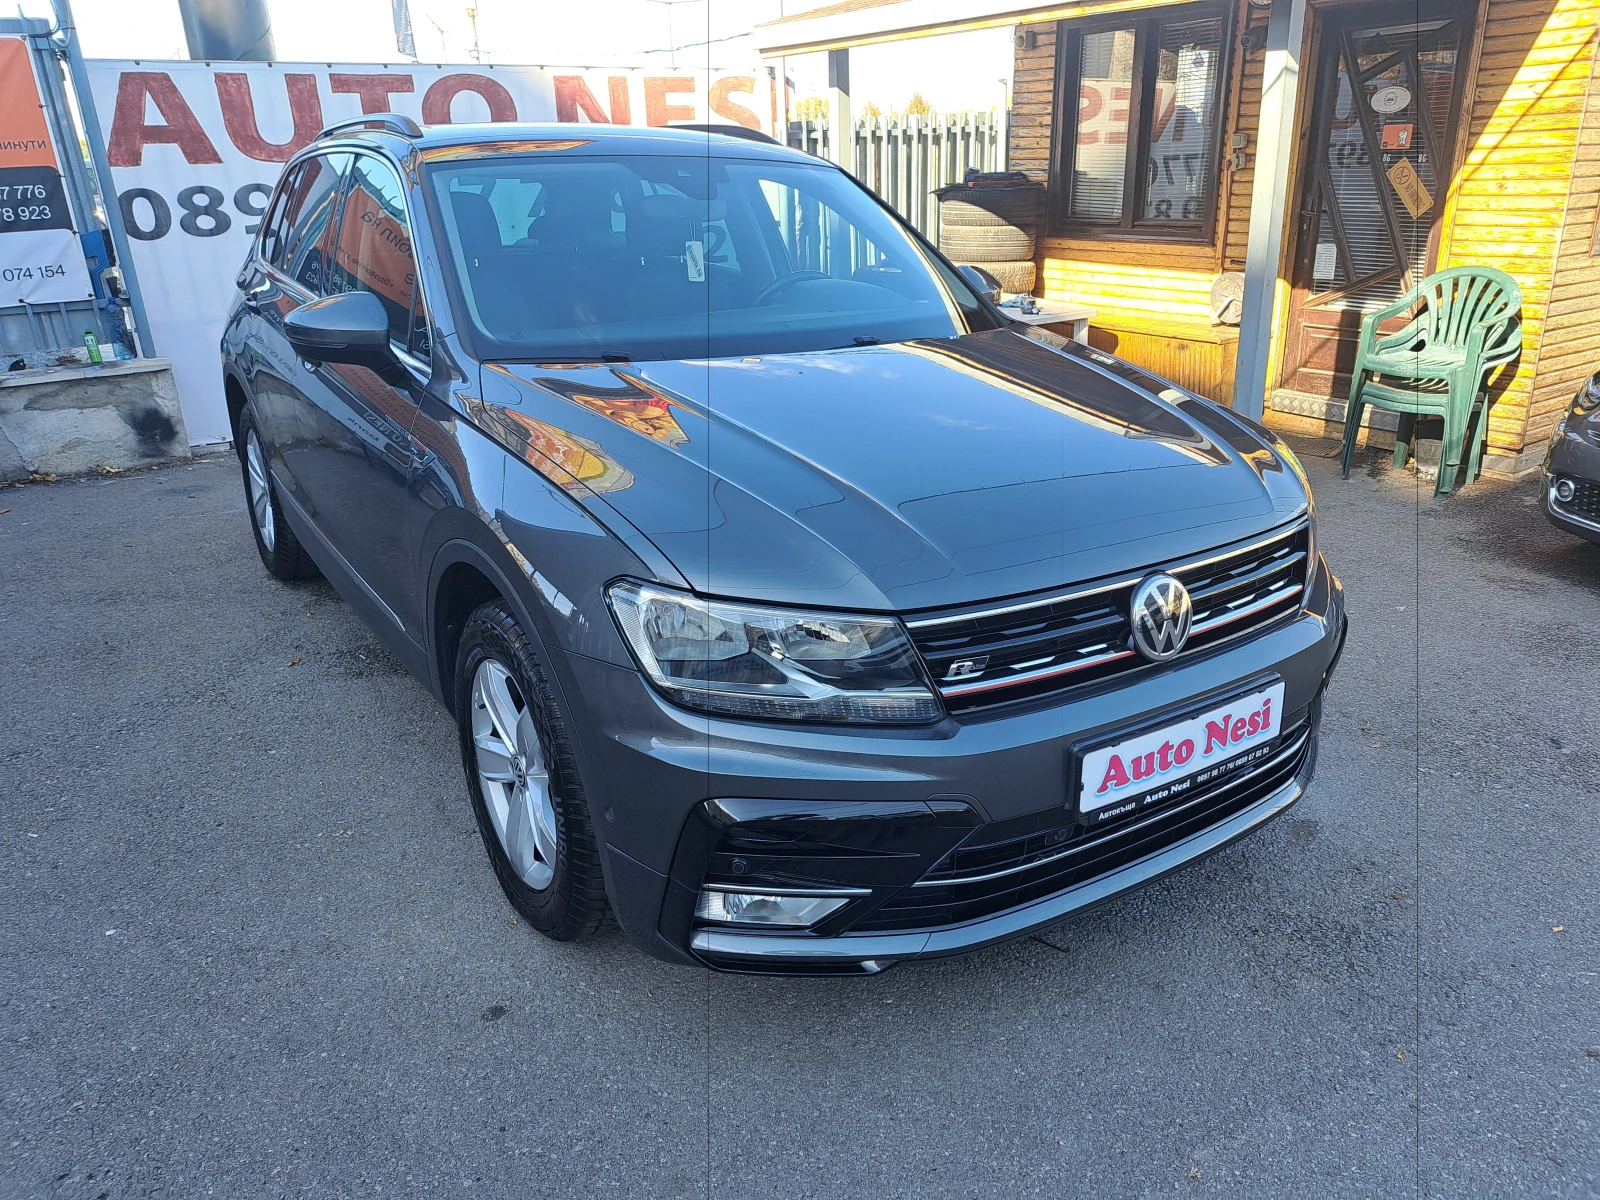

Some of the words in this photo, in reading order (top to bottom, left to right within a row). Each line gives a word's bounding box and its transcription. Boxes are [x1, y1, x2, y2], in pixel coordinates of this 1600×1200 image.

[107, 72, 518, 167] AUTO
[0, 140, 47, 152] инути
[13, 184, 46, 200] 776
[18, 205, 52, 221] 923
[3, 267, 34, 282] 074
[37, 264, 66, 279] 154
[1096, 738, 1195, 794] Auto
[1203, 697, 1272, 755] Nesi
[1098, 801, 1136, 821] Автокъща
[1143, 790, 1168, 805] Auto
[1170, 779, 1191, 794] Nesi
